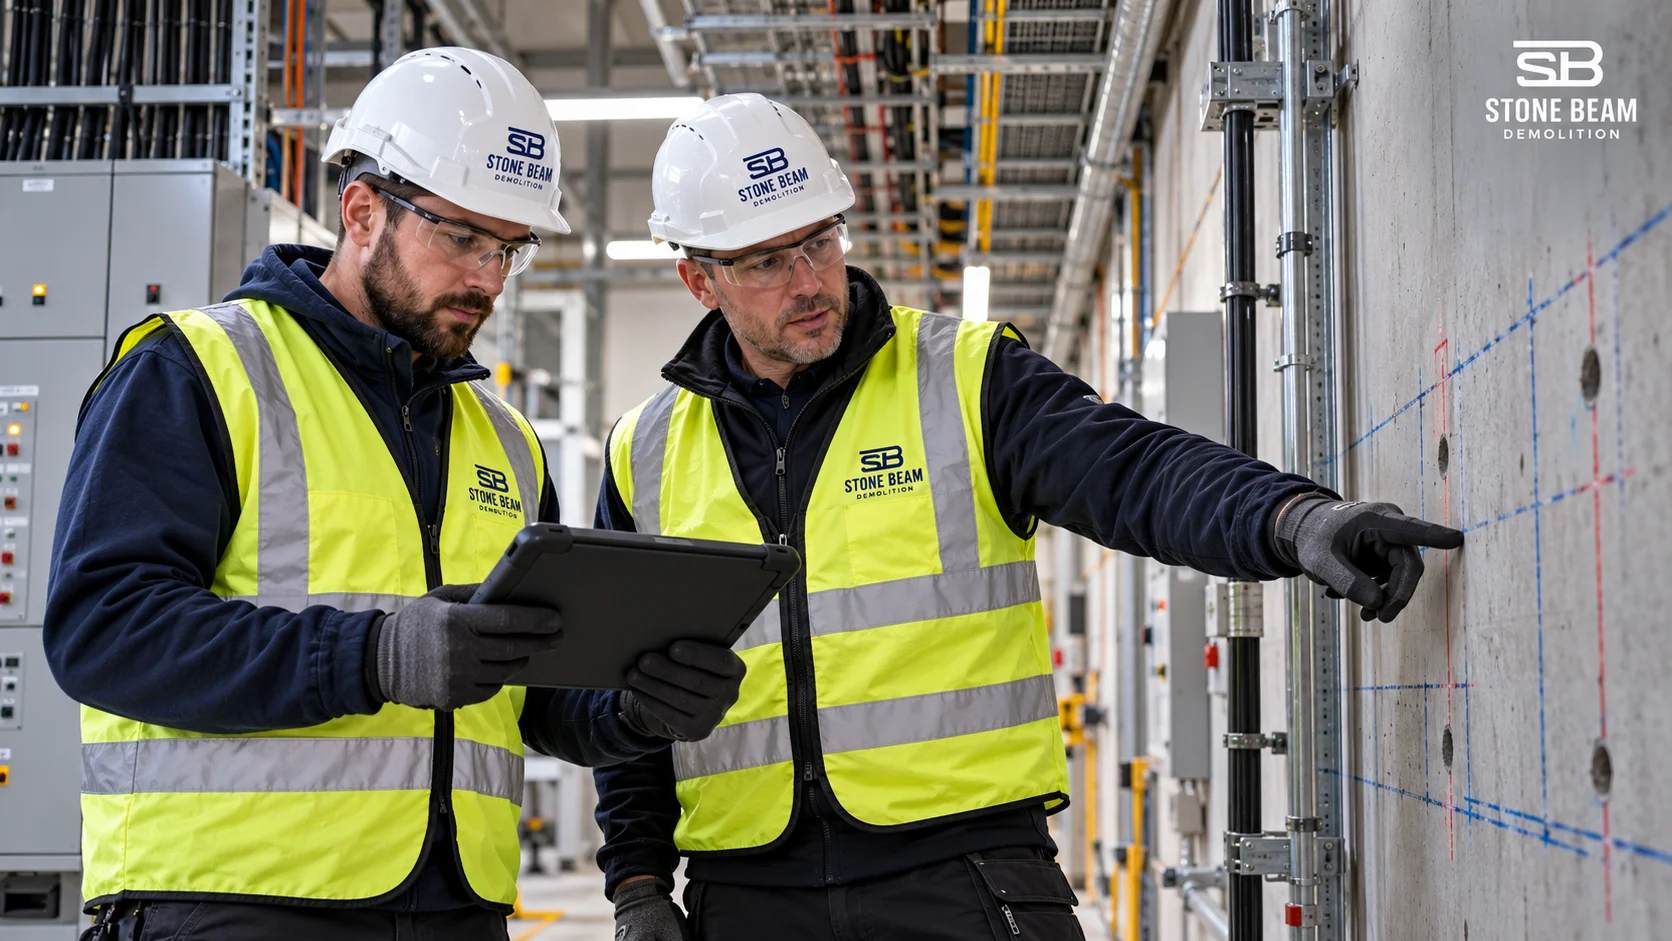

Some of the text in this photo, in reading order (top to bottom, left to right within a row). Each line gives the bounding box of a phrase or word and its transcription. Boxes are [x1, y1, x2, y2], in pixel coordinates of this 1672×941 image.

[486, 154, 553, 183] STONE BEAM
[494, 174, 543, 190] DEMOLITION
[738, 167, 809, 202] STONE BEAM
[753, 185, 805, 207] DEMOLITION
[844, 468, 924, 493] STONE BEAM
[856, 486, 914, 500] DEMOLITION
[468, 487, 522, 513] STONE BEAM
